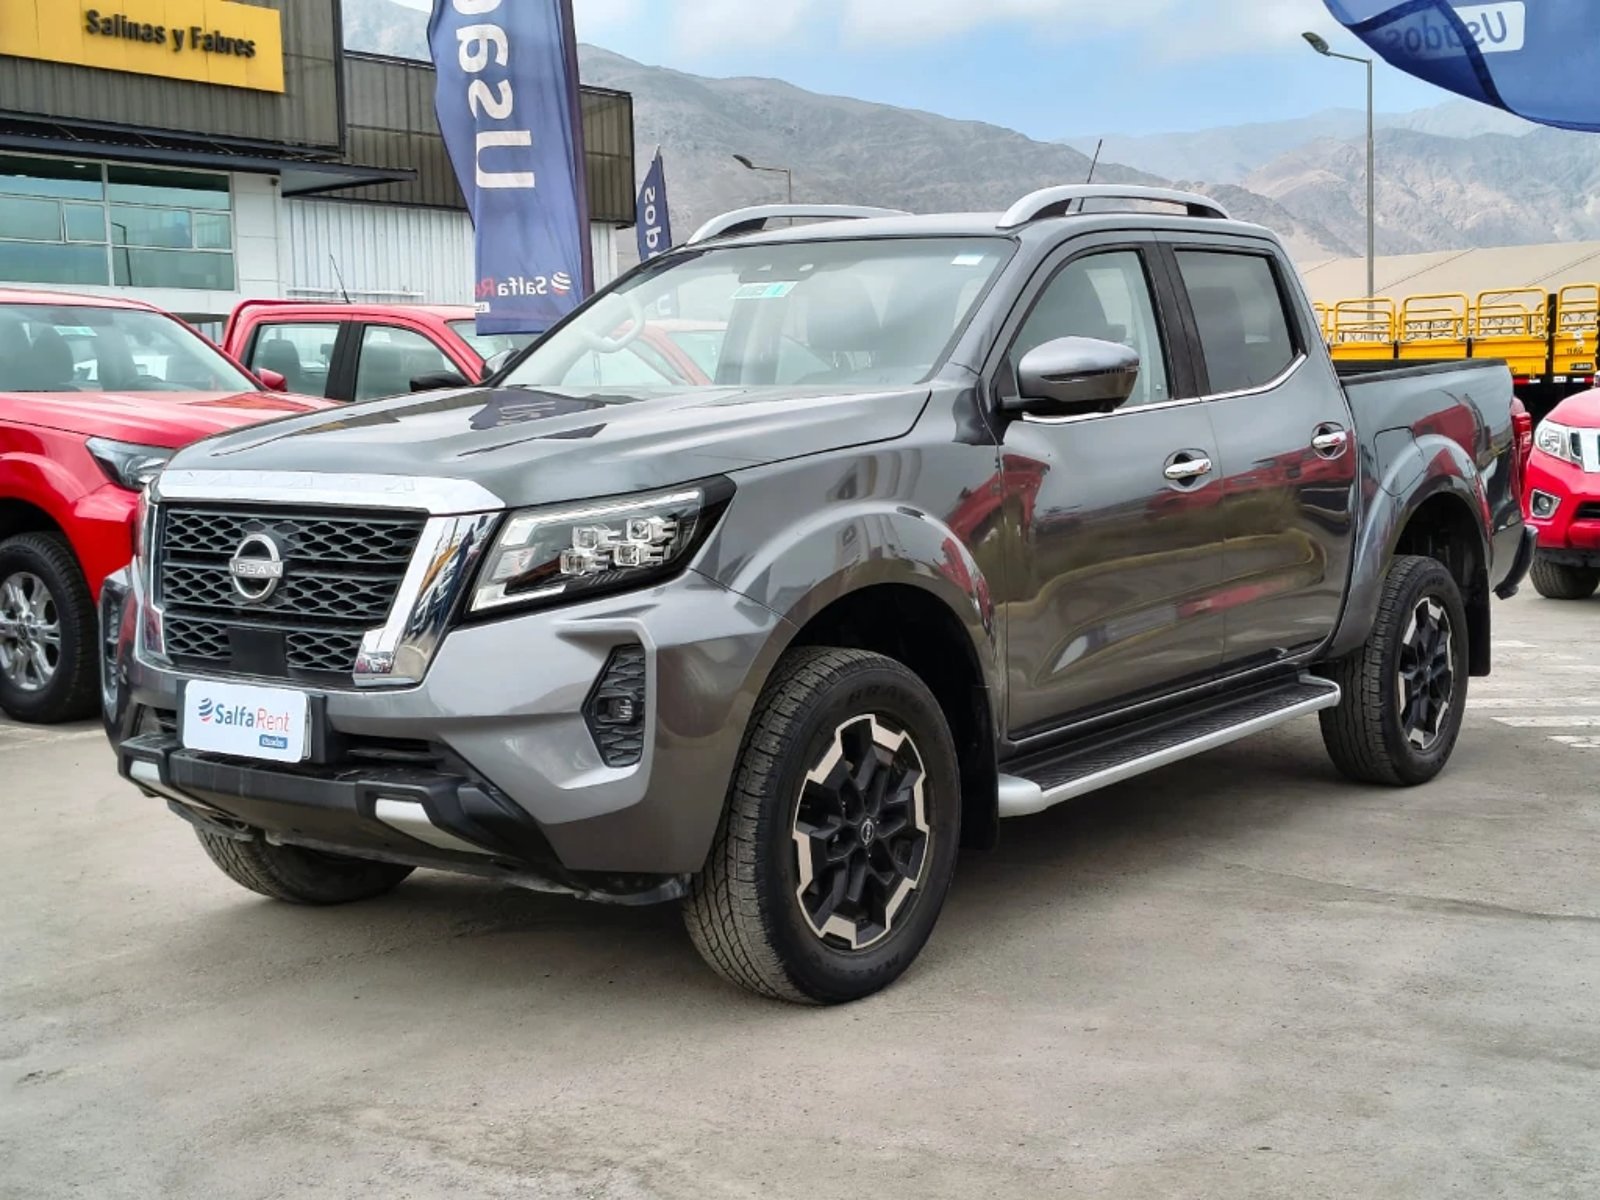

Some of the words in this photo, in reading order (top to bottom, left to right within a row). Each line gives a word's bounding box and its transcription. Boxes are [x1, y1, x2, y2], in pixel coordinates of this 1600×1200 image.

[85, 9, 166, 44] Salinas
[171, 28, 185, 52] y
[189, 26, 256, 58] Fabres
[215, 703, 290, 732] SalfaRent
